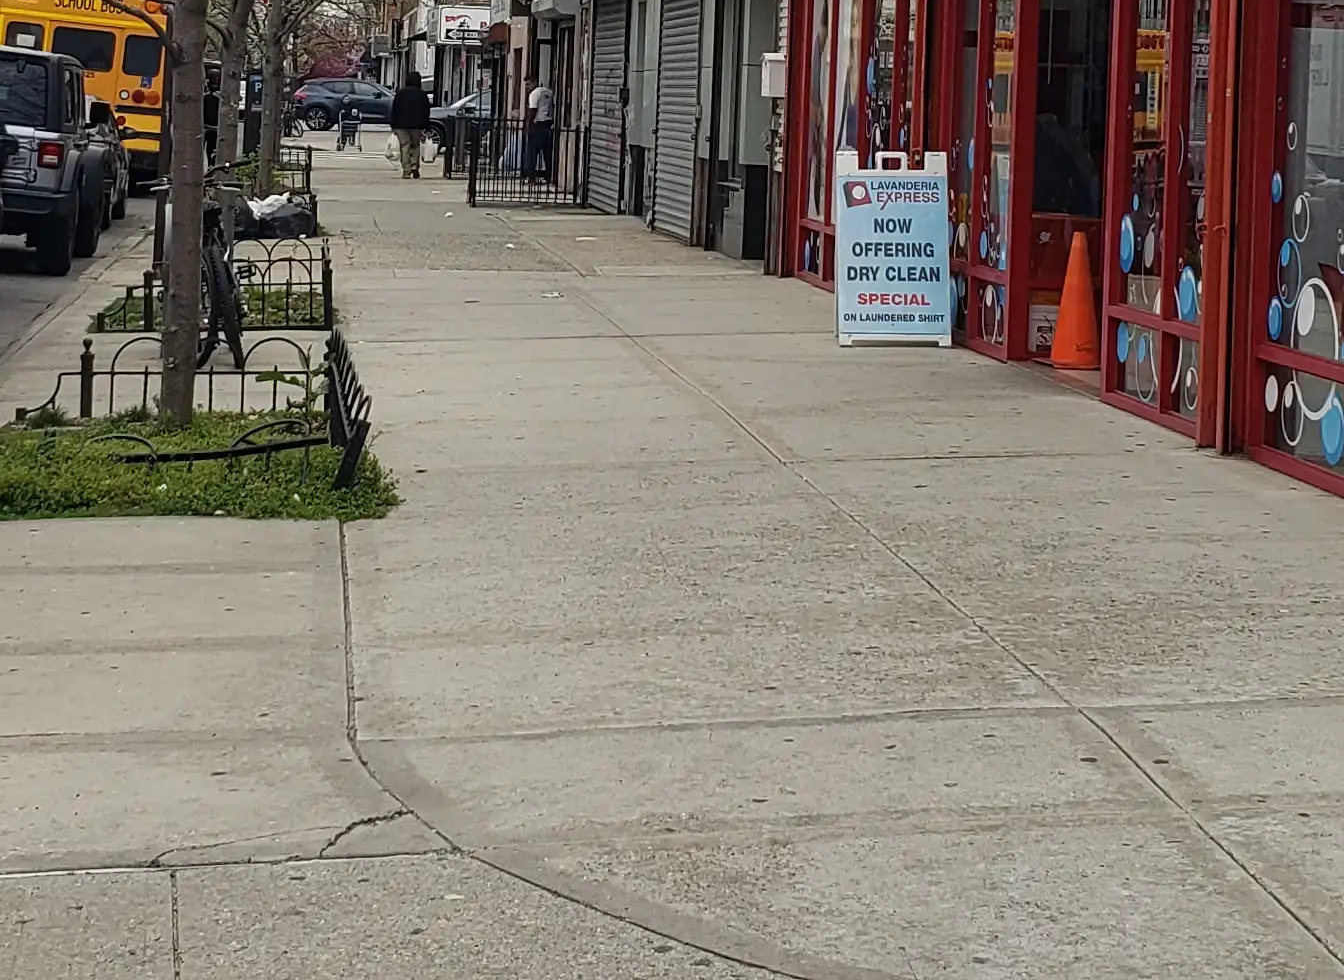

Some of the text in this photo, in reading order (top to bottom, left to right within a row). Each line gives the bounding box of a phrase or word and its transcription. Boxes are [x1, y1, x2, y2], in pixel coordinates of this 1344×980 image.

[870, 180, 940, 191] LAVANDERIA
[875, 191, 940, 211] EXPRESS
[873, 217, 913, 234] NOW
[851, 241, 935, 258] OFFERING
[846, 266, 941, 283] DRY CLEAN
[857, 293, 931, 306] SPECIAL
[843, 312, 946, 324] ON LAUNDERED SHIRT
